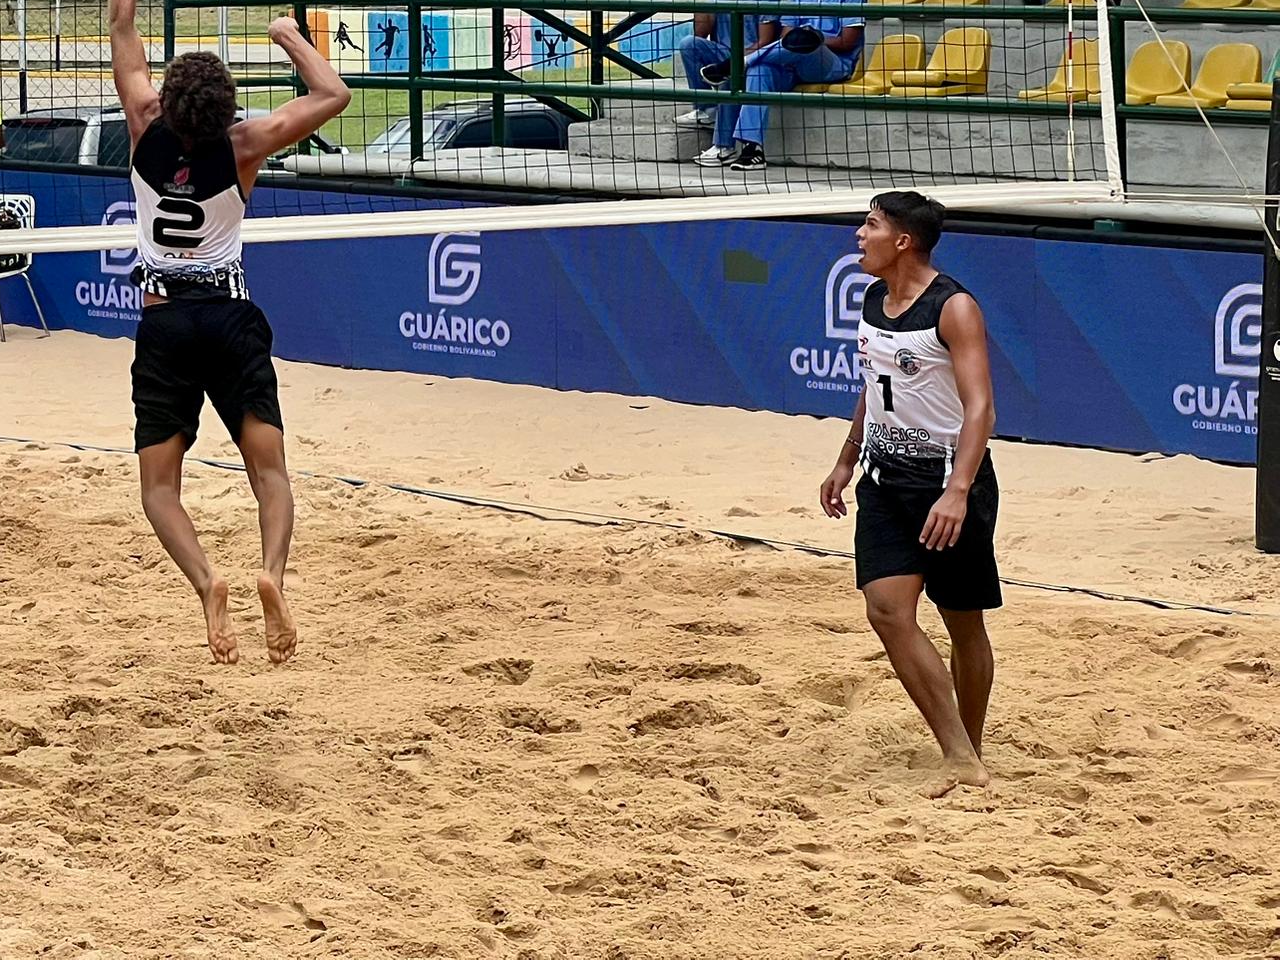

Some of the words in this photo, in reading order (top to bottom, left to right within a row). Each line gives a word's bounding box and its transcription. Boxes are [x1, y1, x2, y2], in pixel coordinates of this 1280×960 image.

[153, 198, 205, 248] 2
[75, 278, 144, 310] GUÁRI
[399, 308, 510, 347] GUÁRICO
[412, 342, 448, 353] GOBIERNO
[449, 345, 497, 358] BOLIVARIANO
[806, 380, 849, 392] GOBIERNO
[876, 374, 895, 412] 1
[1192, 419, 1242, 433] GOBIERNO
[878, 440, 919, 456] 2025
